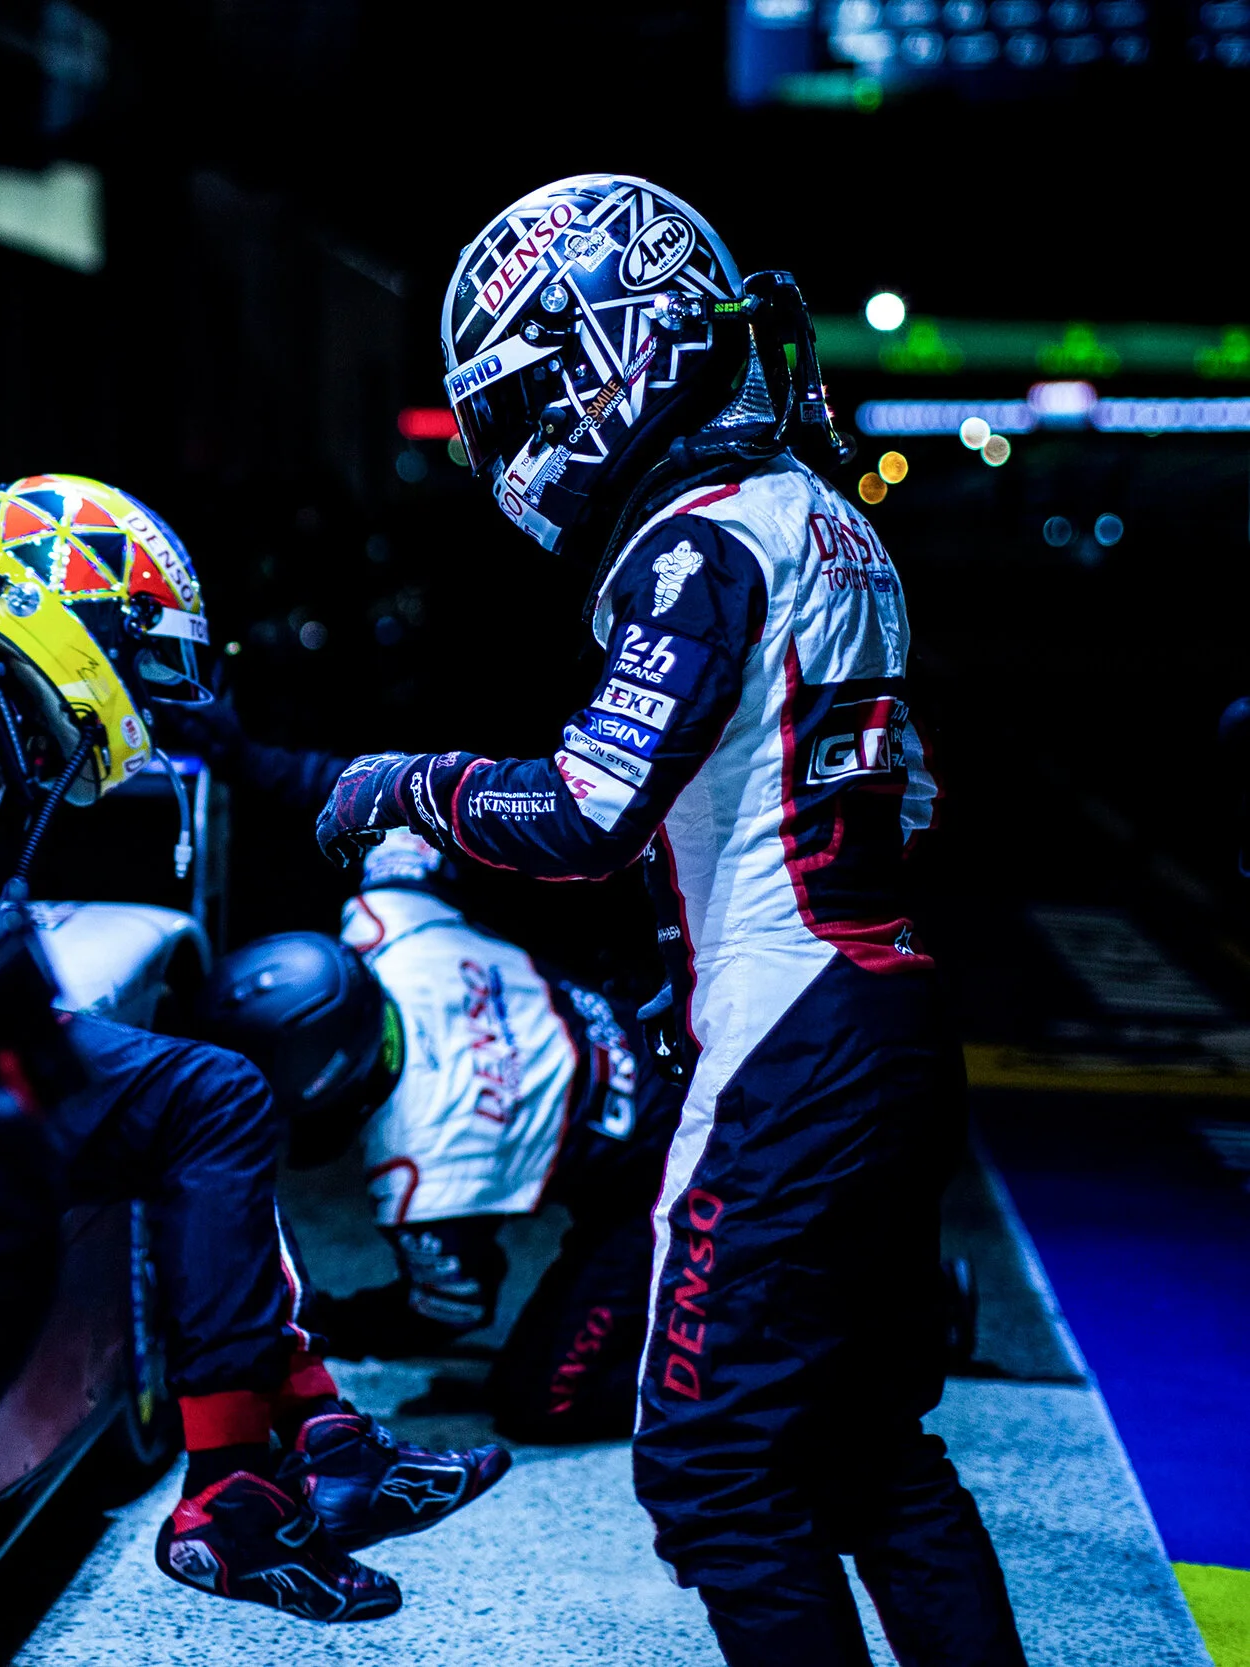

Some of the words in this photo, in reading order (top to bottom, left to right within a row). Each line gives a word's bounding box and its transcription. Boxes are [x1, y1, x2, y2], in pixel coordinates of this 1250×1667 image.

[482, 203, 572, 312] DENSO
[636, 218, 687, 285] Arai
[450, 354, 503, 398] BRID
[568, 415, 594, 444] GOOD
[586, 380, 621, 418] SMILE
[591, 388, 627, 430] COMPANY
[619, 623, 676, 674] 24h
[571, 732, 606, 758] NIPPON
[605, 753, 643, 778] STEEL
[589, 716, 650, 749] AISIN
[815, 727, 889, 776] GR
[483, 798, 556, 814] KINSHUKAI
[663, 1187, 724, 1401] DENSO
